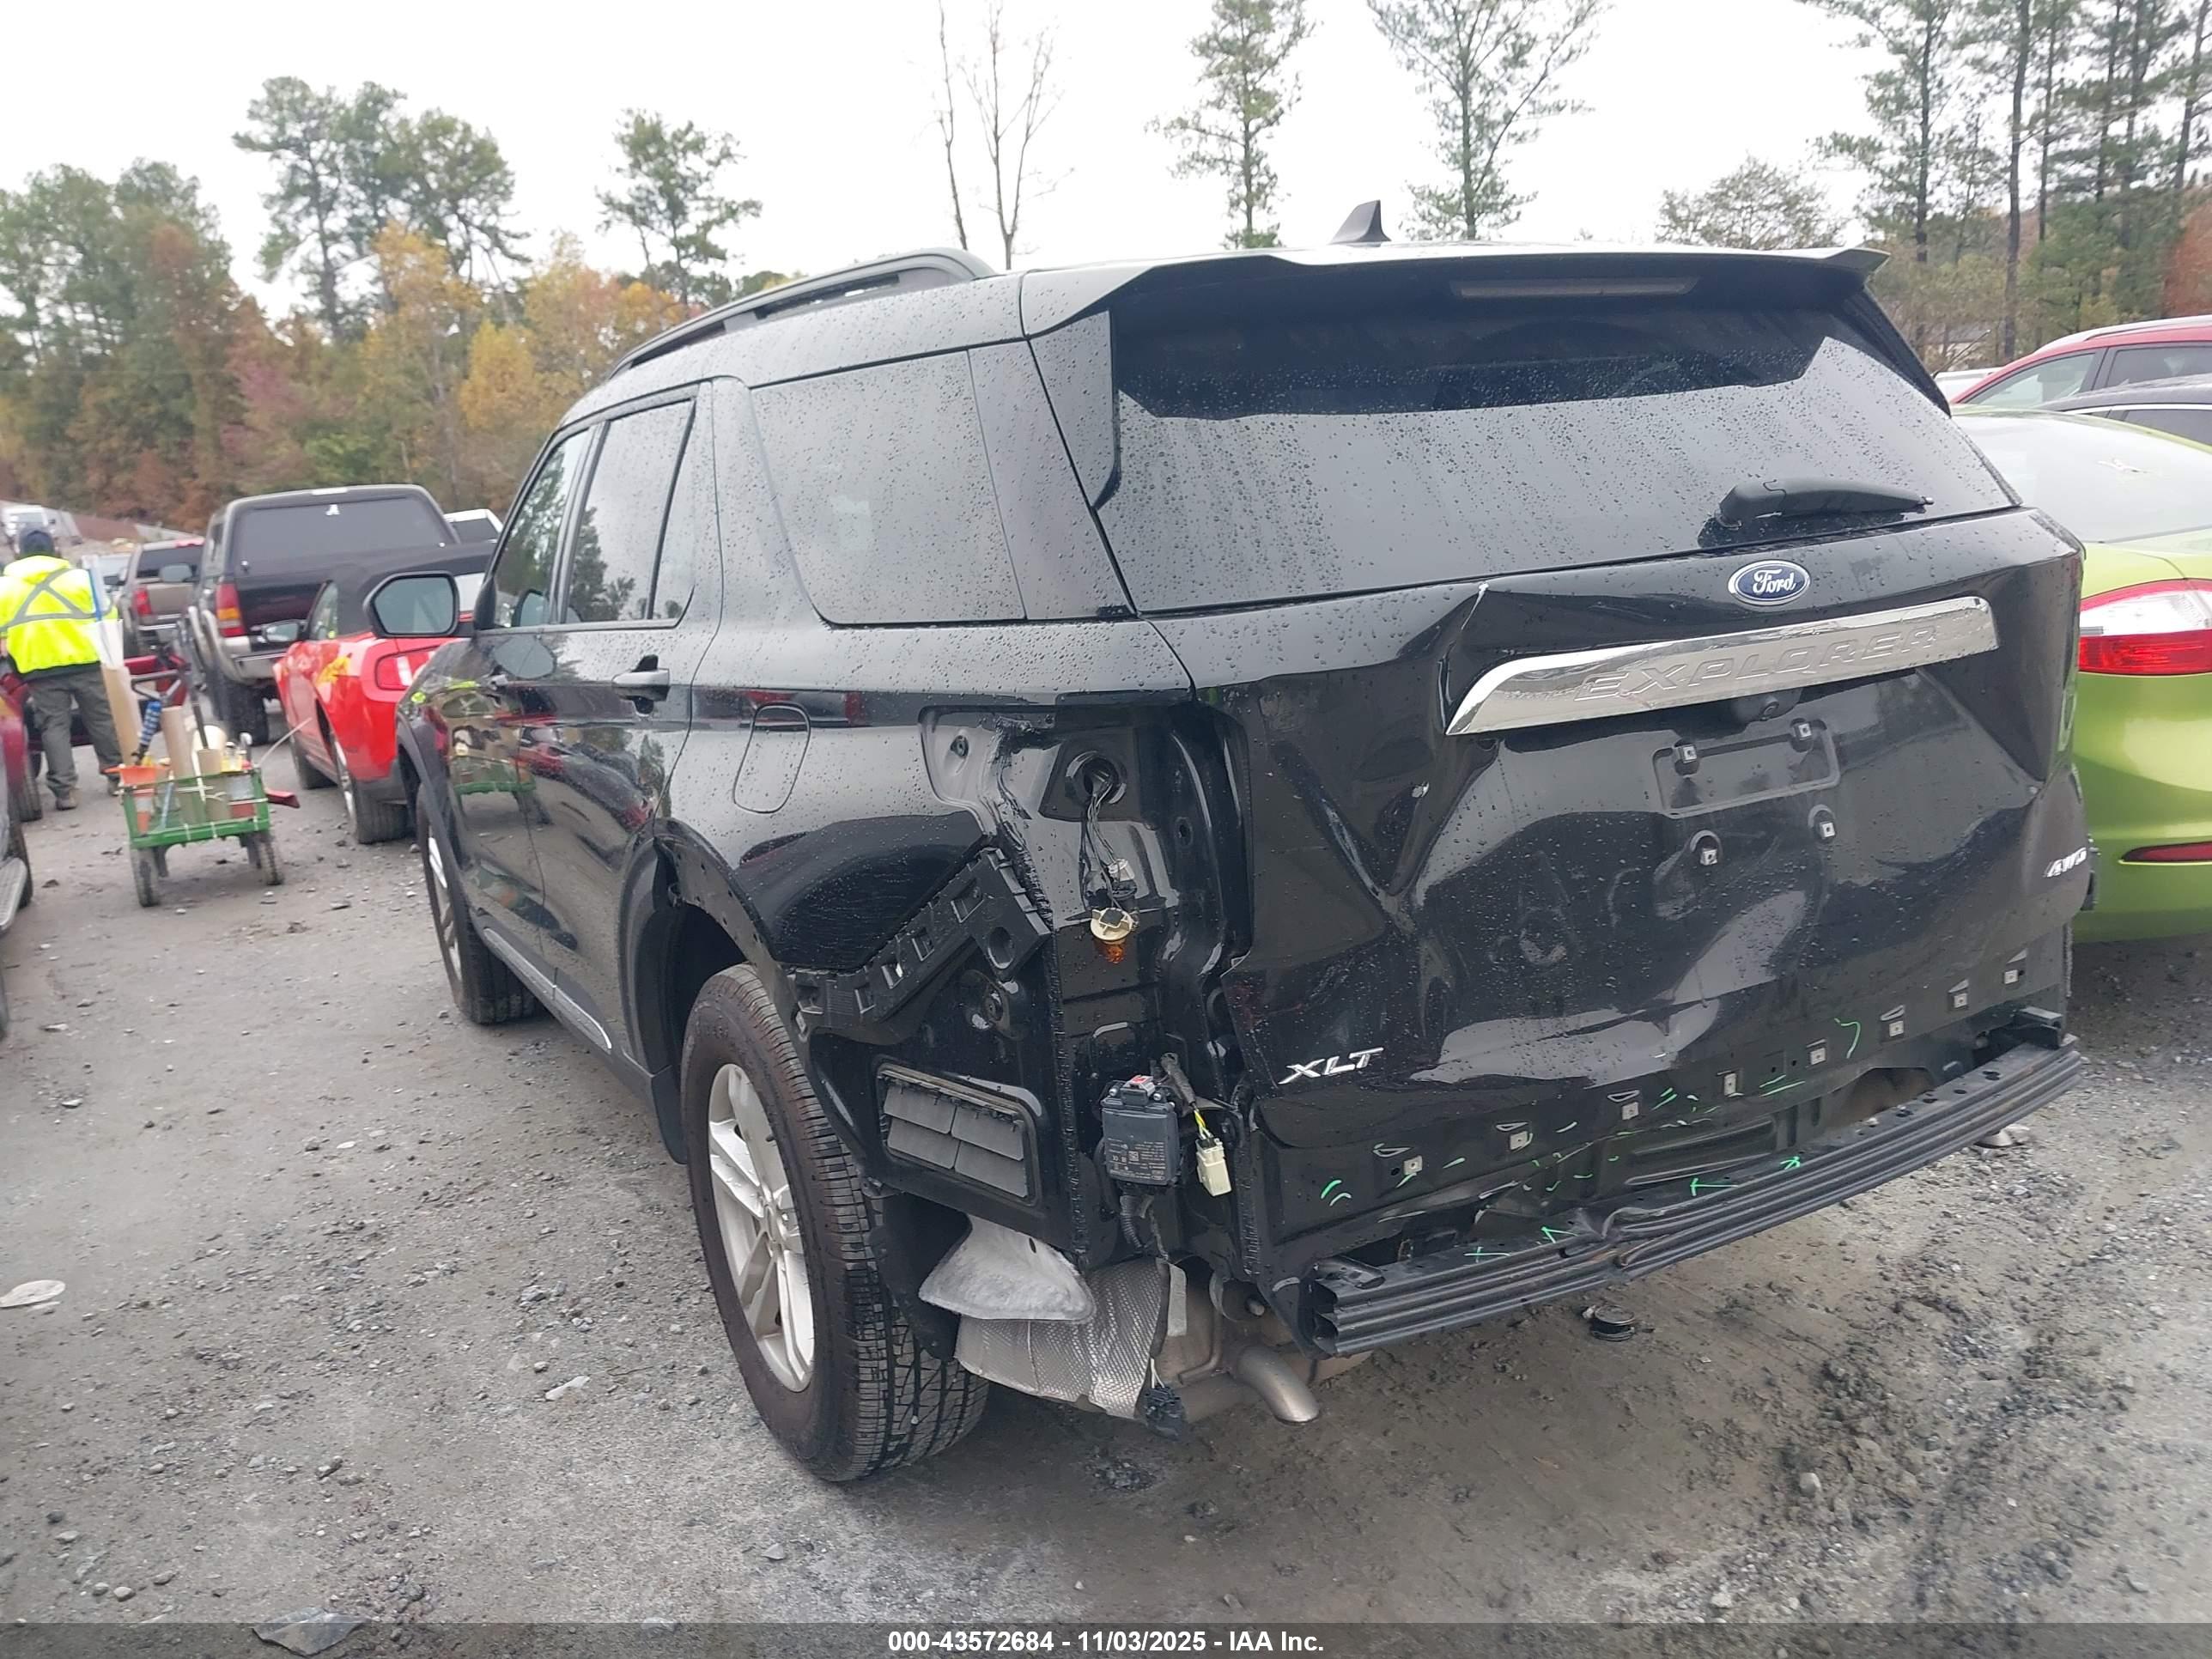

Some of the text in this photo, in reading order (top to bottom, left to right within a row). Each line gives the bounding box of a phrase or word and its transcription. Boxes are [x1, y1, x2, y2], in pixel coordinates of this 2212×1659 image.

[1753, 568, 1796, 595] Ford
[1574, 625, 1939, 702] EXPLORER
[1277, 1047, 1384, 1085] XLT
